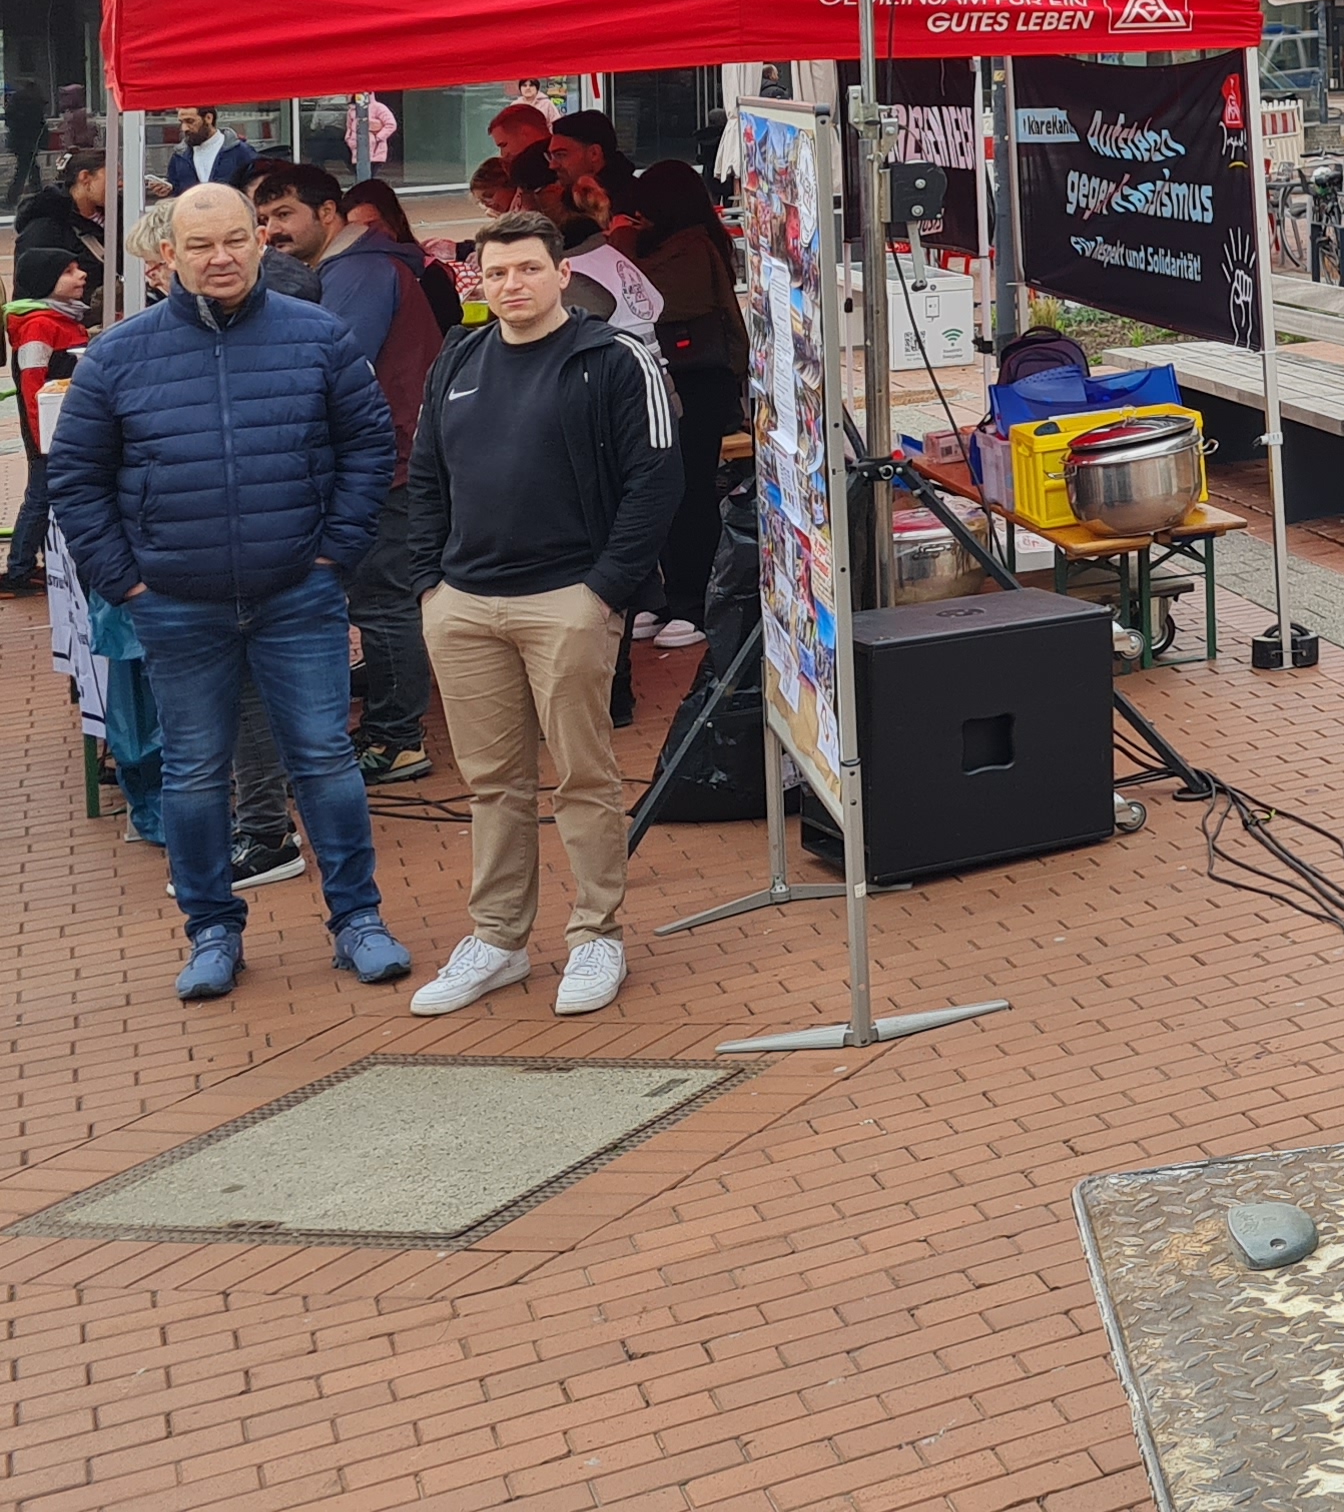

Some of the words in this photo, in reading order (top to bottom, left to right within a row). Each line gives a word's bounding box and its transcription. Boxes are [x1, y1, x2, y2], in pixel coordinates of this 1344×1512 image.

[926, 11, 1011, 34] GUTES
[1016, 10, 1095, 32] LEBEN
[1066, 169, 1117, 216] gegen
[1126, 244, 1146, 271] und
[1147, 246, 1202, 282] Solidarität!
